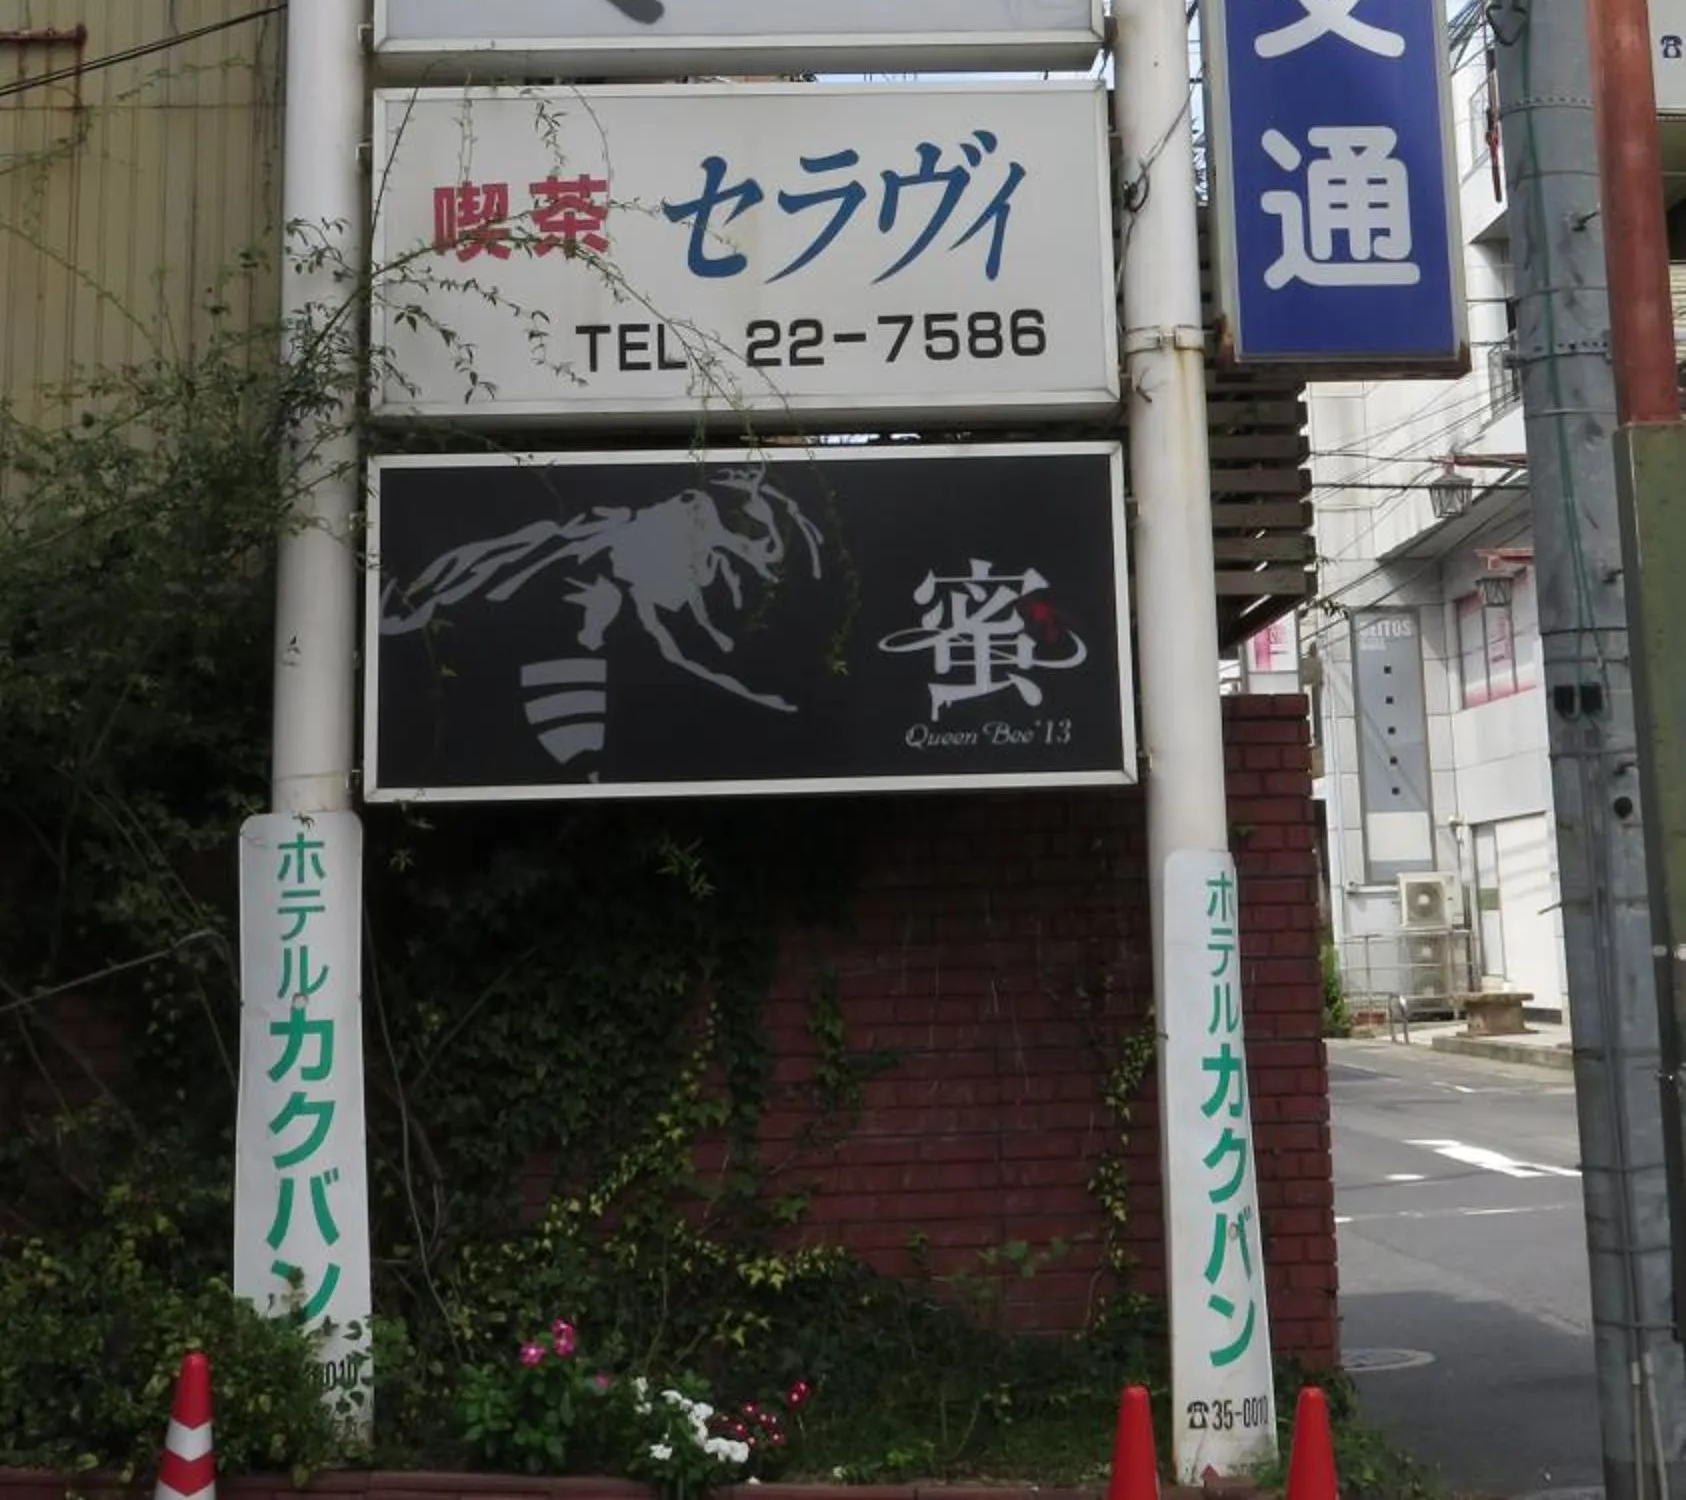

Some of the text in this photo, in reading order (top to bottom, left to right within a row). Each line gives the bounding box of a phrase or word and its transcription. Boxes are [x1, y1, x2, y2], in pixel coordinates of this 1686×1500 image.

[433, 129, 1028, 285] 喫茶 セラヴィ
[576, 308, 1048, 373] TEL 22-7586
[911, 557, 1052, 722] 蜜
[905, 722, 978, 749] Queen
